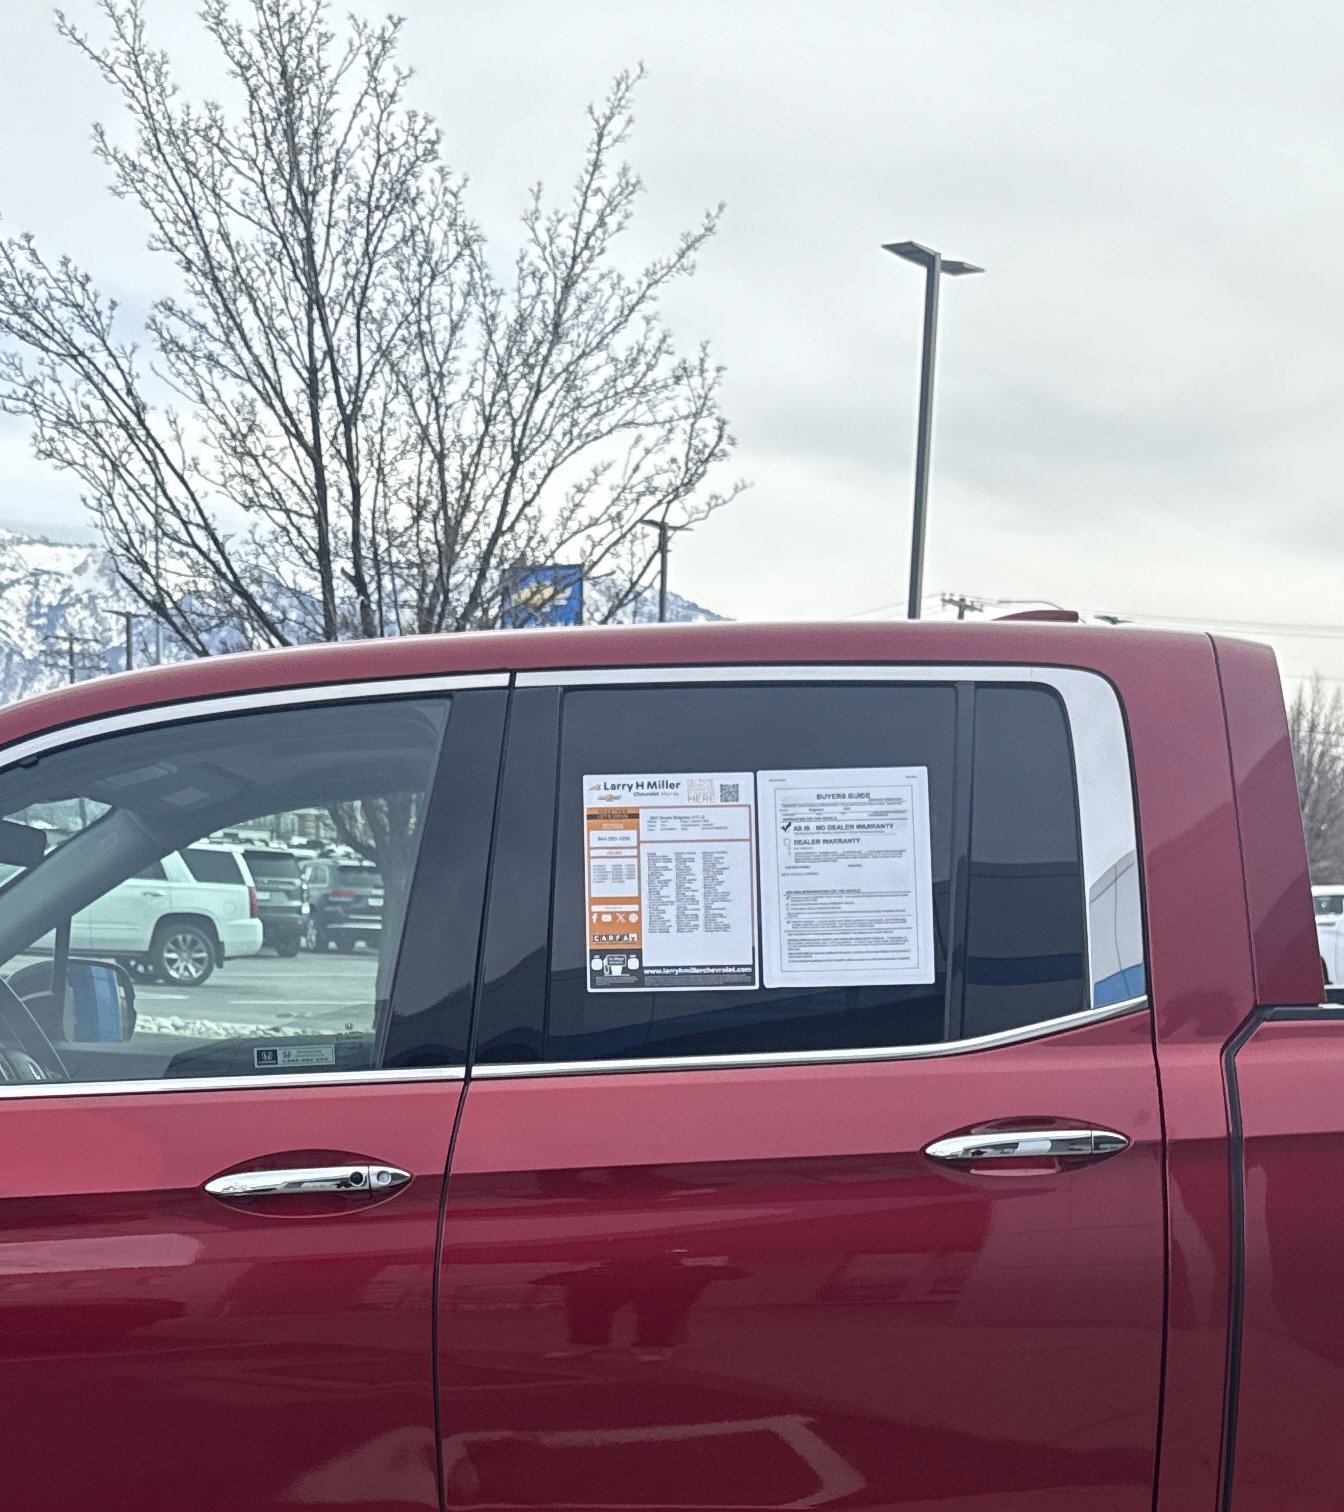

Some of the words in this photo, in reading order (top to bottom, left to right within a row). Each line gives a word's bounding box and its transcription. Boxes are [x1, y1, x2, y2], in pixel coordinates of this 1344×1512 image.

[603, 781, 634, 793] Larry
[636, 780, 644, 790] H
[646, 779, 681, 790] Miller
[687, 794, 715, 803] HERE
[848, 792, 870, 800] GUIDE
[793, 838, 821, 846] DEALER
